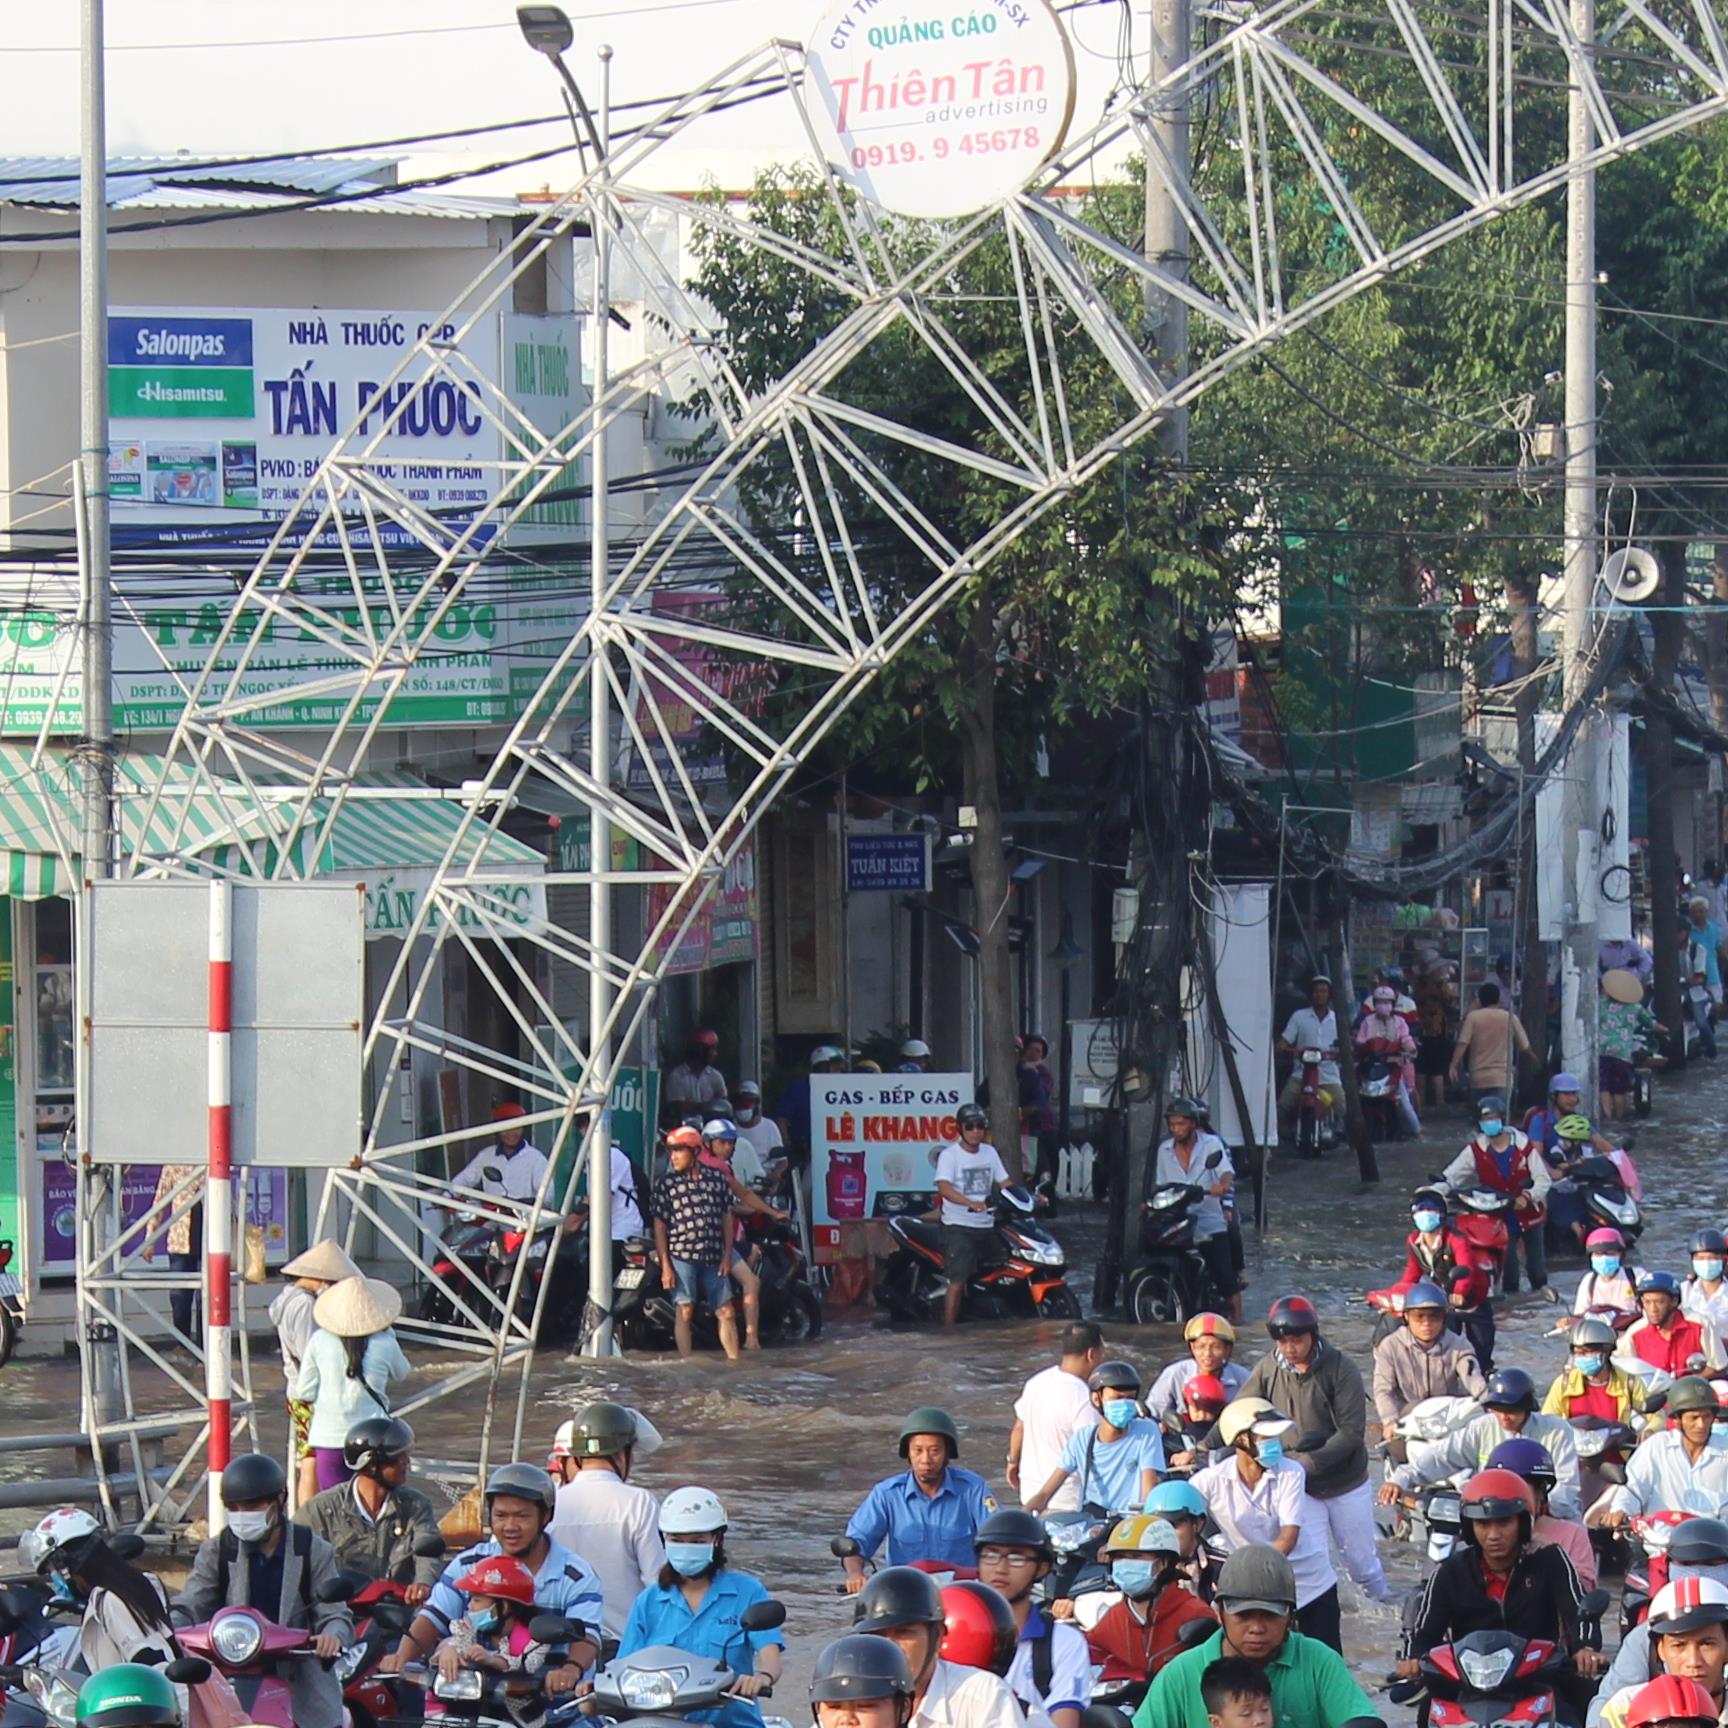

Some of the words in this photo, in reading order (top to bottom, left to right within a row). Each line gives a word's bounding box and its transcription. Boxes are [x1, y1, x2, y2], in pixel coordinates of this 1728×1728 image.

[830, 17, 857, 50] CTY
[868, 15, 945, 49] QUẢNG
[951, 12, 998, 38] CÁO
[830, 57, 958, 134] Thiên
[962, 58, 1045, 97] Tân
[925, 97, 1049, 125] advertising
[851, 142, 926, 170] 0919.
[933, 137, 951, 160] 9
[958, 126, 1041, 157] 45678
[136, 327, 225, 361] Salonpas
[288, 317, 329, 346] NHÀ
[340, 315, 405, 347] THUỐC
[137, 381, 226, 403] Hisamitsu
[263, 360, 339, 436] TẤN
[260, 459, 296, 478] PVKD
[825, 1090, 864, 1106] GAS
[879, 1084, 916, 1105] BẾP
[920, 1090, 960, 1105] GAS
[825, 1111, 856, 1143] LÊ
[862, 1115, 960, 1142] KHANG
[99, 1695, 143, 1707] HONDA
